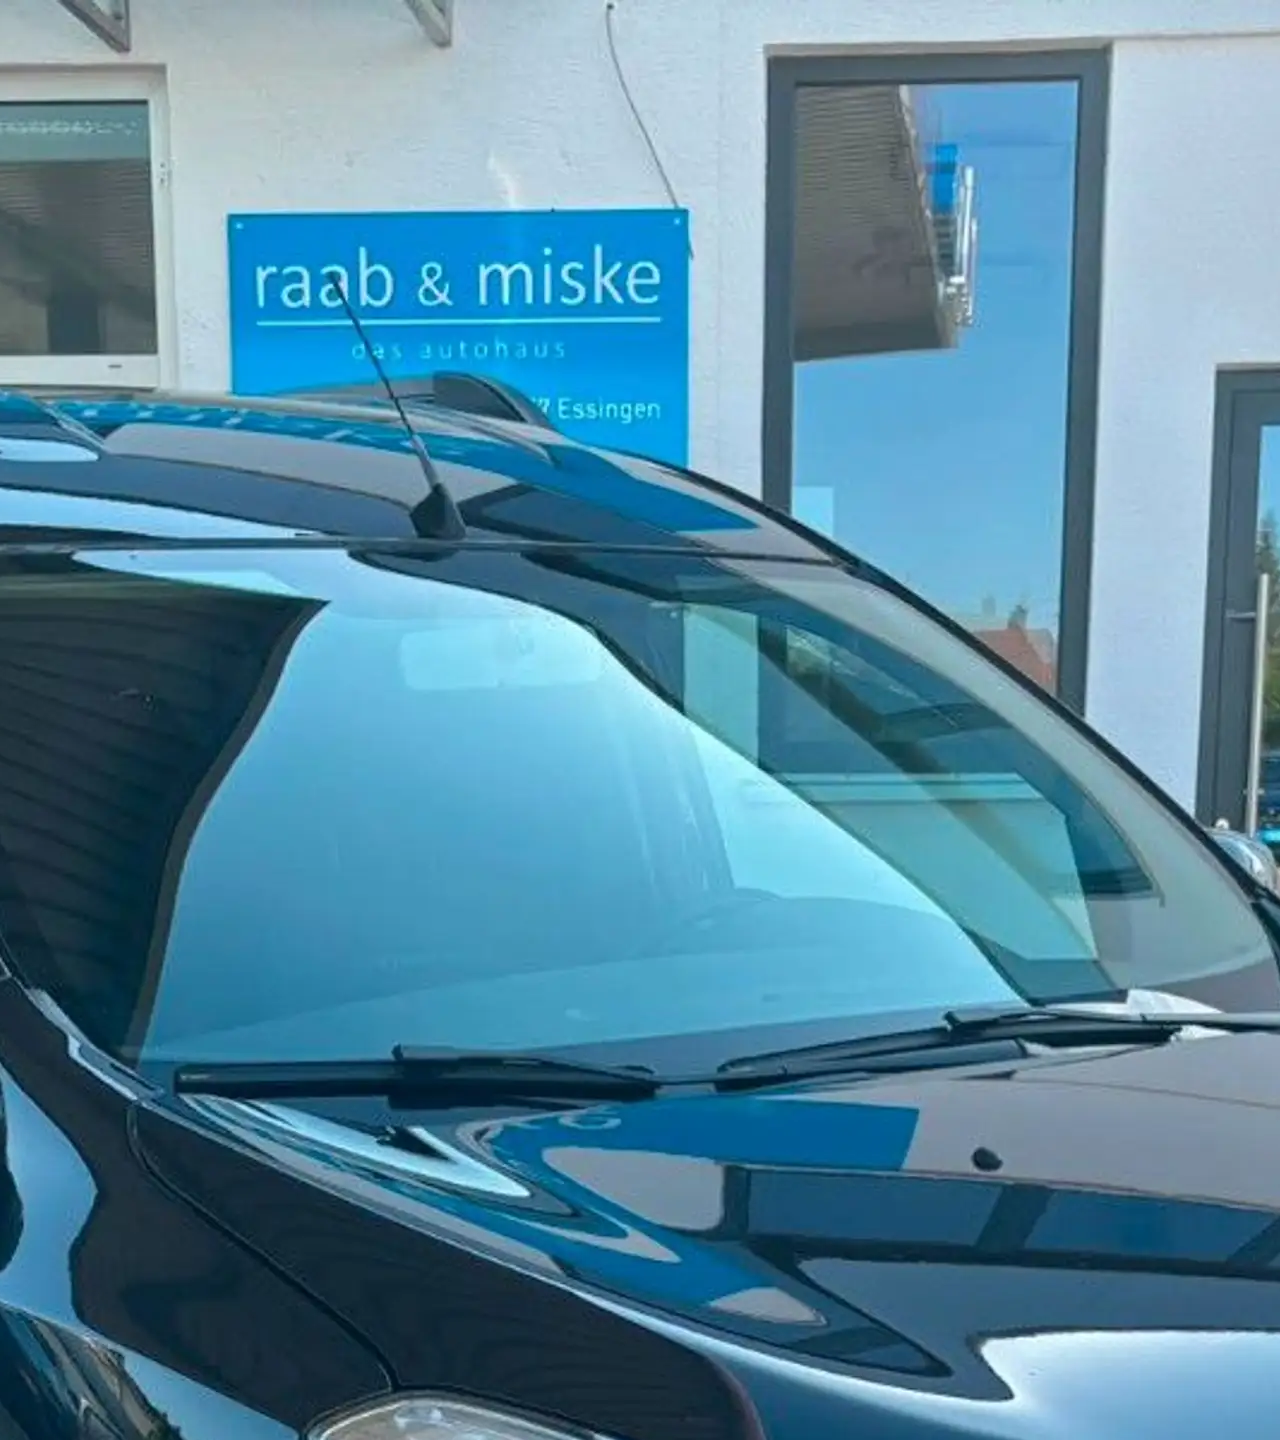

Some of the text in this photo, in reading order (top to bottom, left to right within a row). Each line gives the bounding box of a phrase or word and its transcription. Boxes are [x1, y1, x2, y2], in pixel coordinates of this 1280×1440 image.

[255, 244, 662, 309] raab & miske
[352, 337, 566, 360] das autohaus
[557, 397, 661, 425] Essingen
